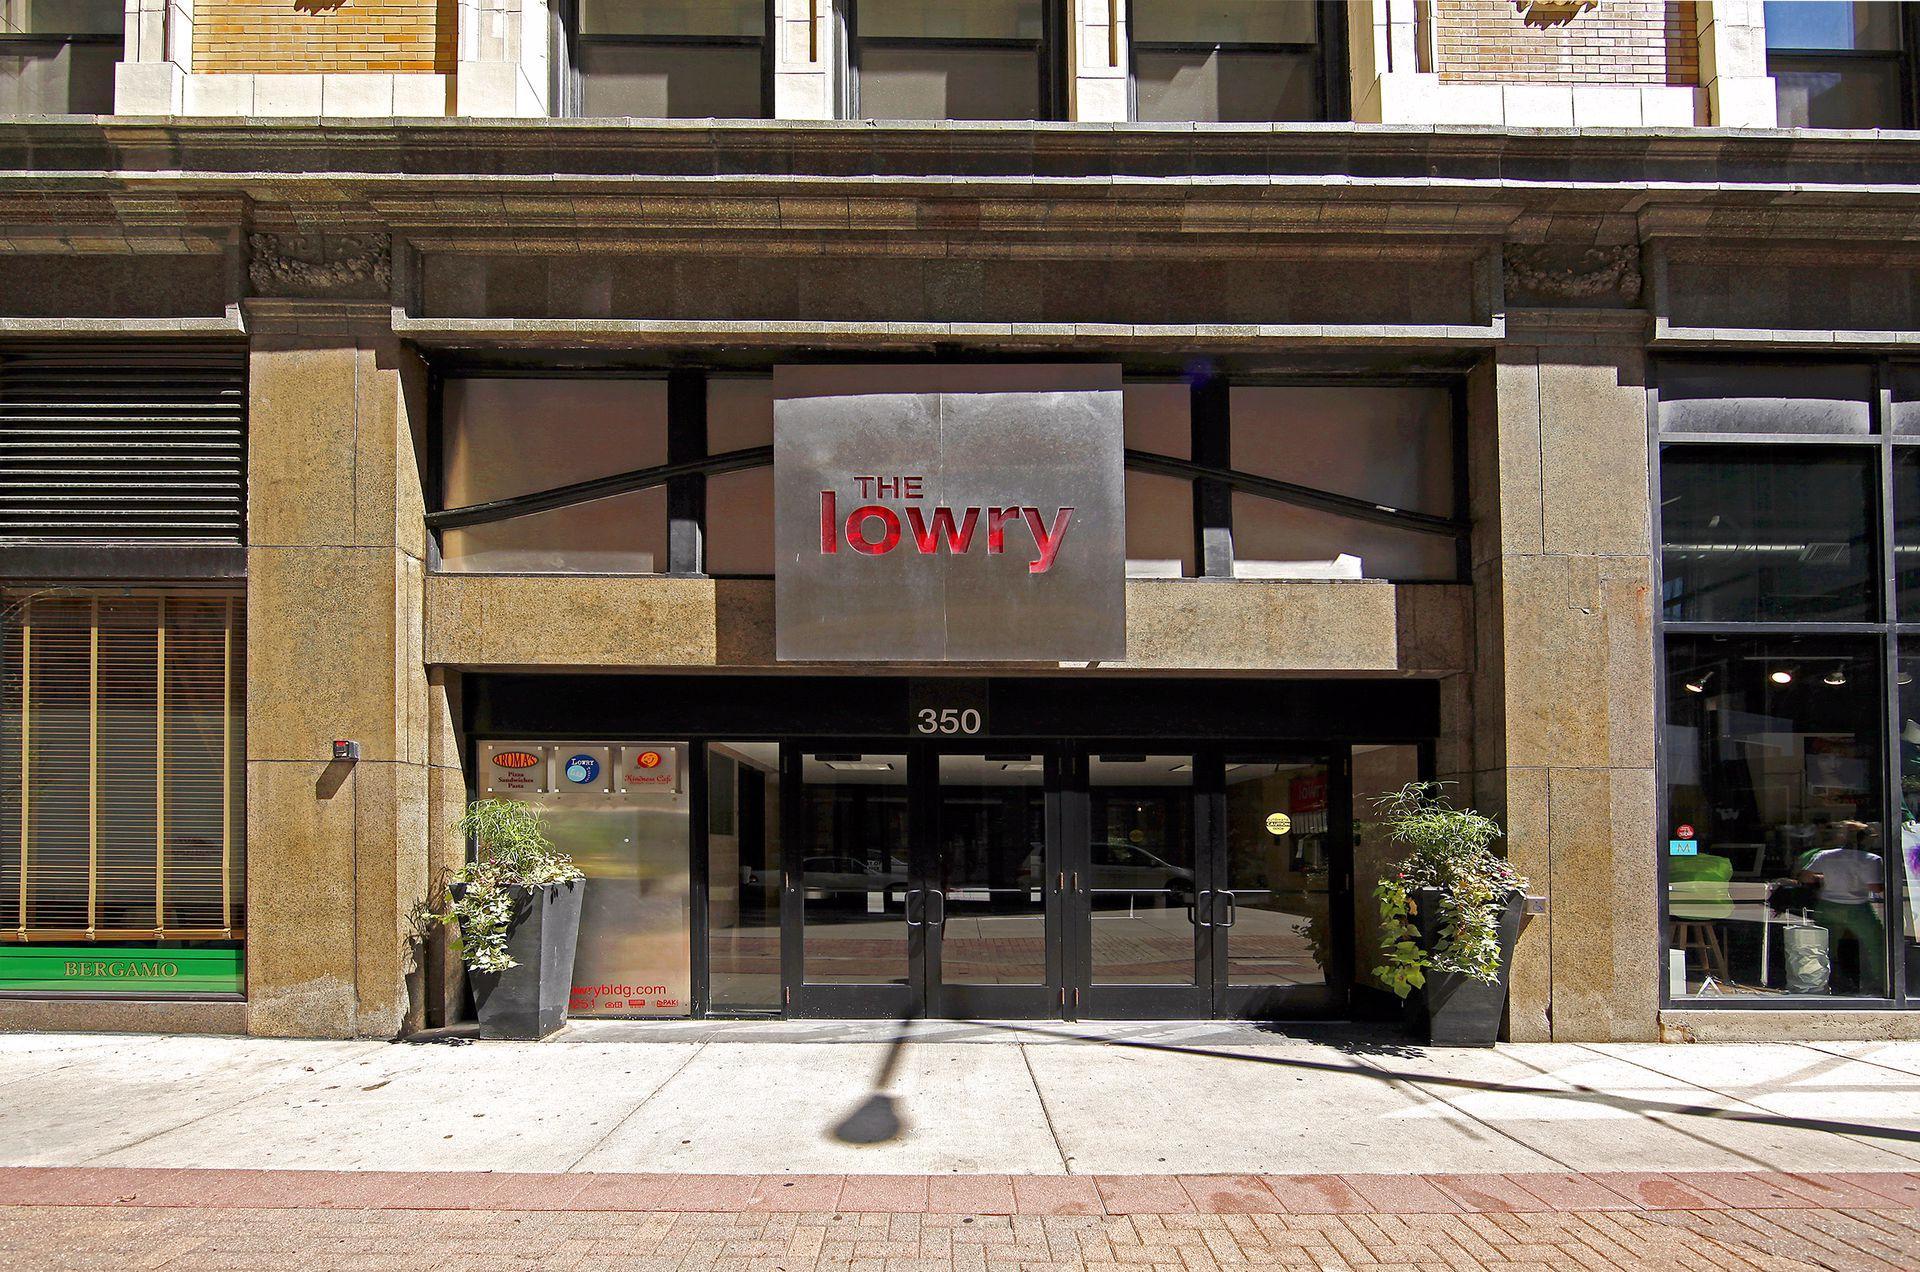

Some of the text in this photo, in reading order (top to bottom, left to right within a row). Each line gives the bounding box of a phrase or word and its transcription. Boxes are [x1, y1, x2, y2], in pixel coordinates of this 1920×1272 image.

[853, 476, 924, 499] THE
[819, 491, 1075, 574] lowry
[917, 708, 981, 734] 350
[64, 961, 179, 979] BERGAMO
